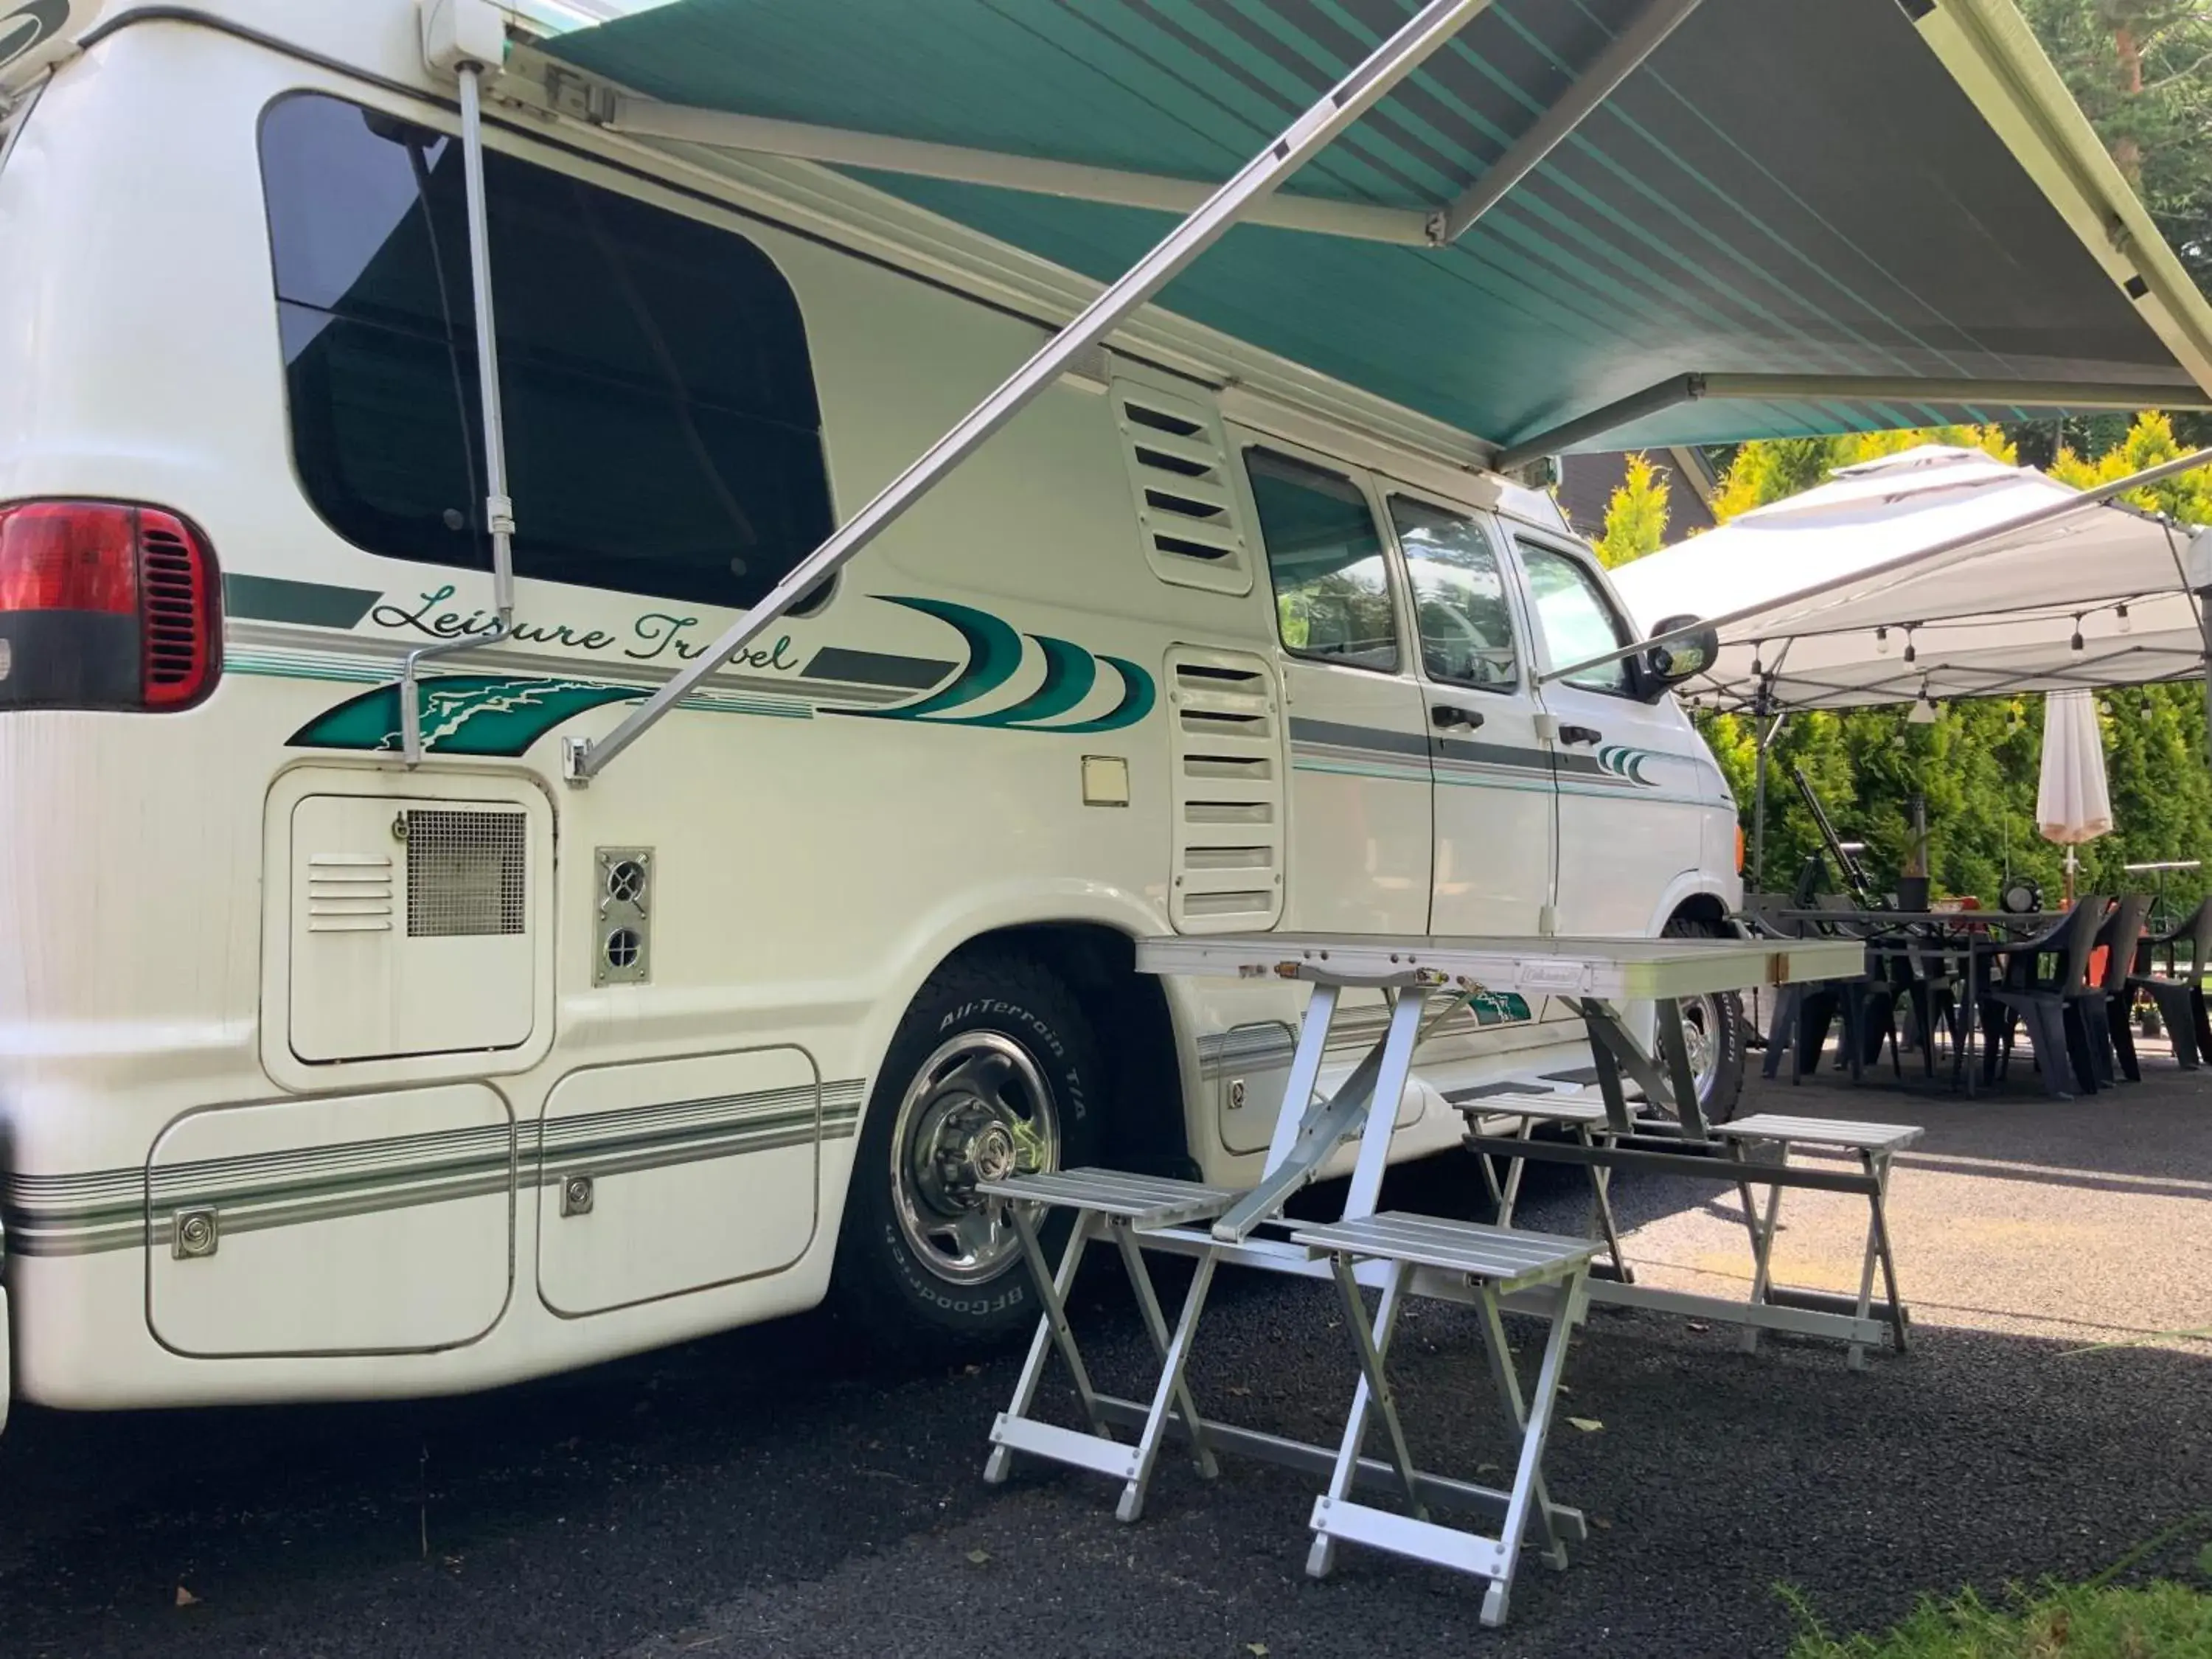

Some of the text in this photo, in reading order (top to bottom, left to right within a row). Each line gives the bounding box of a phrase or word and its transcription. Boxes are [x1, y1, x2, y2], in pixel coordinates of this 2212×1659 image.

[372, 585, 799, 670] Leisure Trvel
[939, 998, 1086, 1121] All-Terrain T/A
[1722, 993, 1736, 1062] odrich
[886, 1224, 1024, 1315] BFGoodrich
